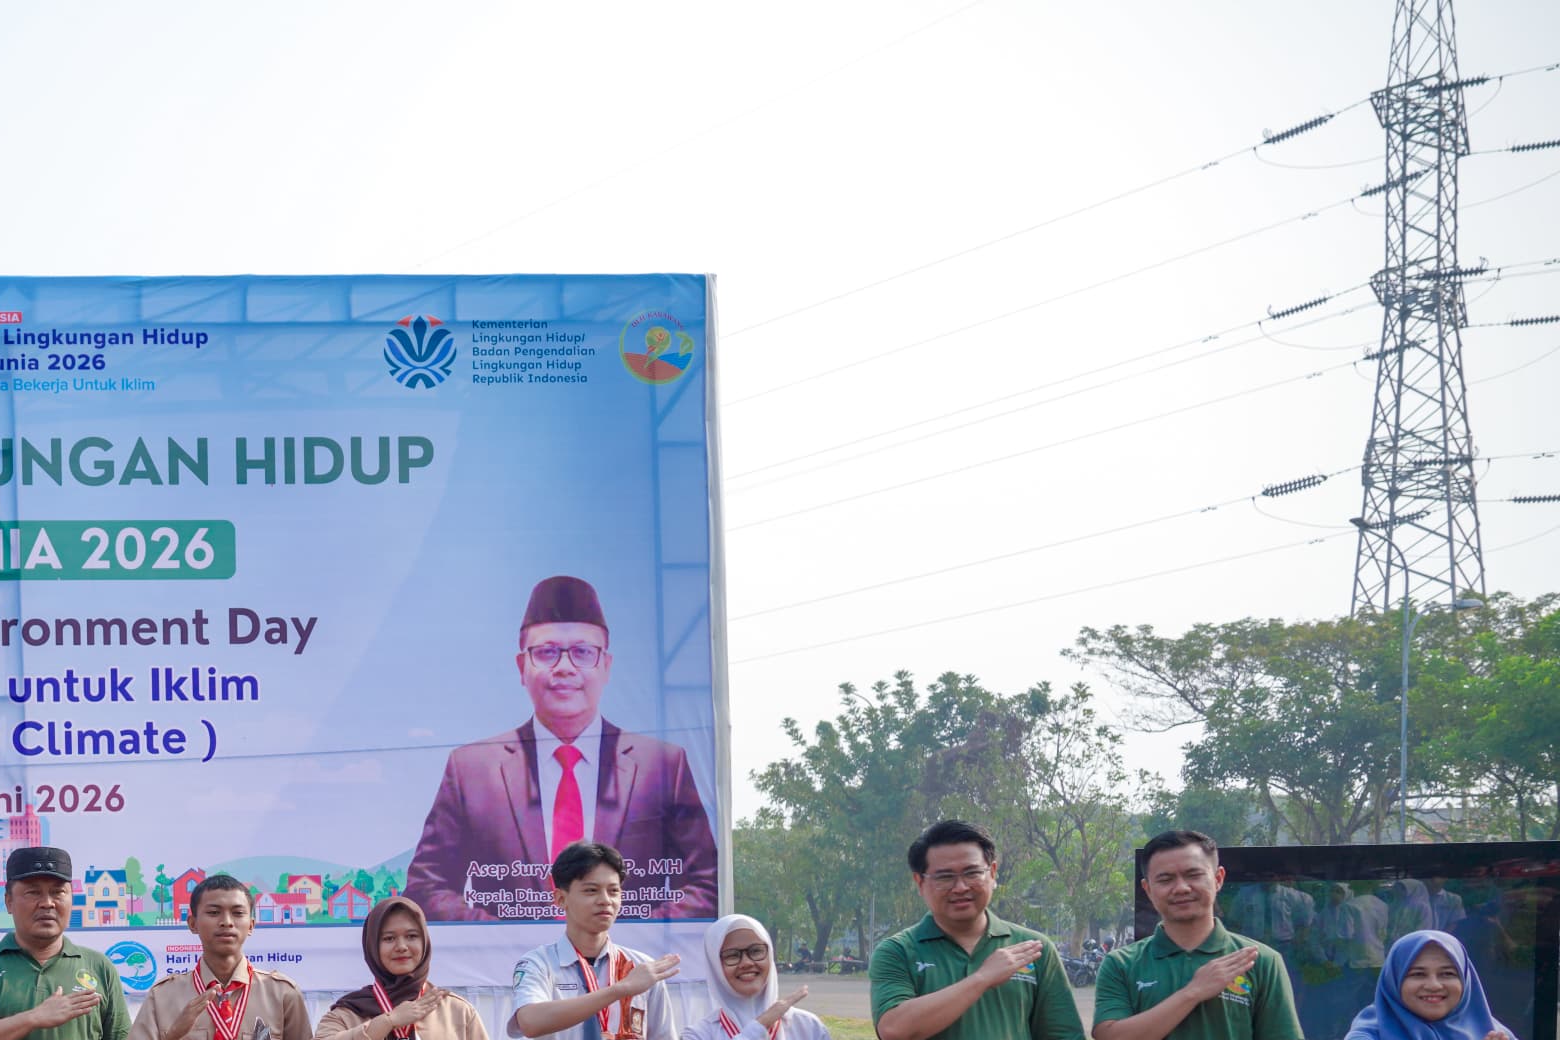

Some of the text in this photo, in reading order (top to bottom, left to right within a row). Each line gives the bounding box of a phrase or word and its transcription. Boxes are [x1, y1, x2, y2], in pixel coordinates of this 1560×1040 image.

[472, 320, 548, 329] Kementerian
[3, 328, 135, 350] Lingkungan
[143, 328, 209, 349] Hidup
[472, 333, 585, 344] Lingkungan Hidup/
[472, 347, 595, 358] Badan Pengendalian
[47, 354, 106, 370] 2026
[472, 360, 582, 372] Lingkungan Hidup
[13, 378, 68, 394] Bekerja
[73, 377, 116, 391] Untuk
[121, 377, 155, 391] Iklim
[473, 374, 588, 385] Republik Indonesia
[236, 436, 434, 485] HIDUP
[80, 527, 215, 570] 2026
[228, 607, 318, 655] Day
[8, 668, 134, 702] untuk
[151, 667, 259, 701] Iklim
[12, 720, 187, 756] Climate
[36, 784, 125, 813] 2026
[467, 861, 509, 880] Asep
[512, 860, 553, 880] Sury
[648, 859, 683, 874] MH
[465, 888, 554, 905] Kepala Dinas
[639, 887, 684, 903] Hidup
[498, 904, 565, 919] Kabupate
[166, 954, 190, 964] Hari
[267, 953, 303, 963] Hidup
